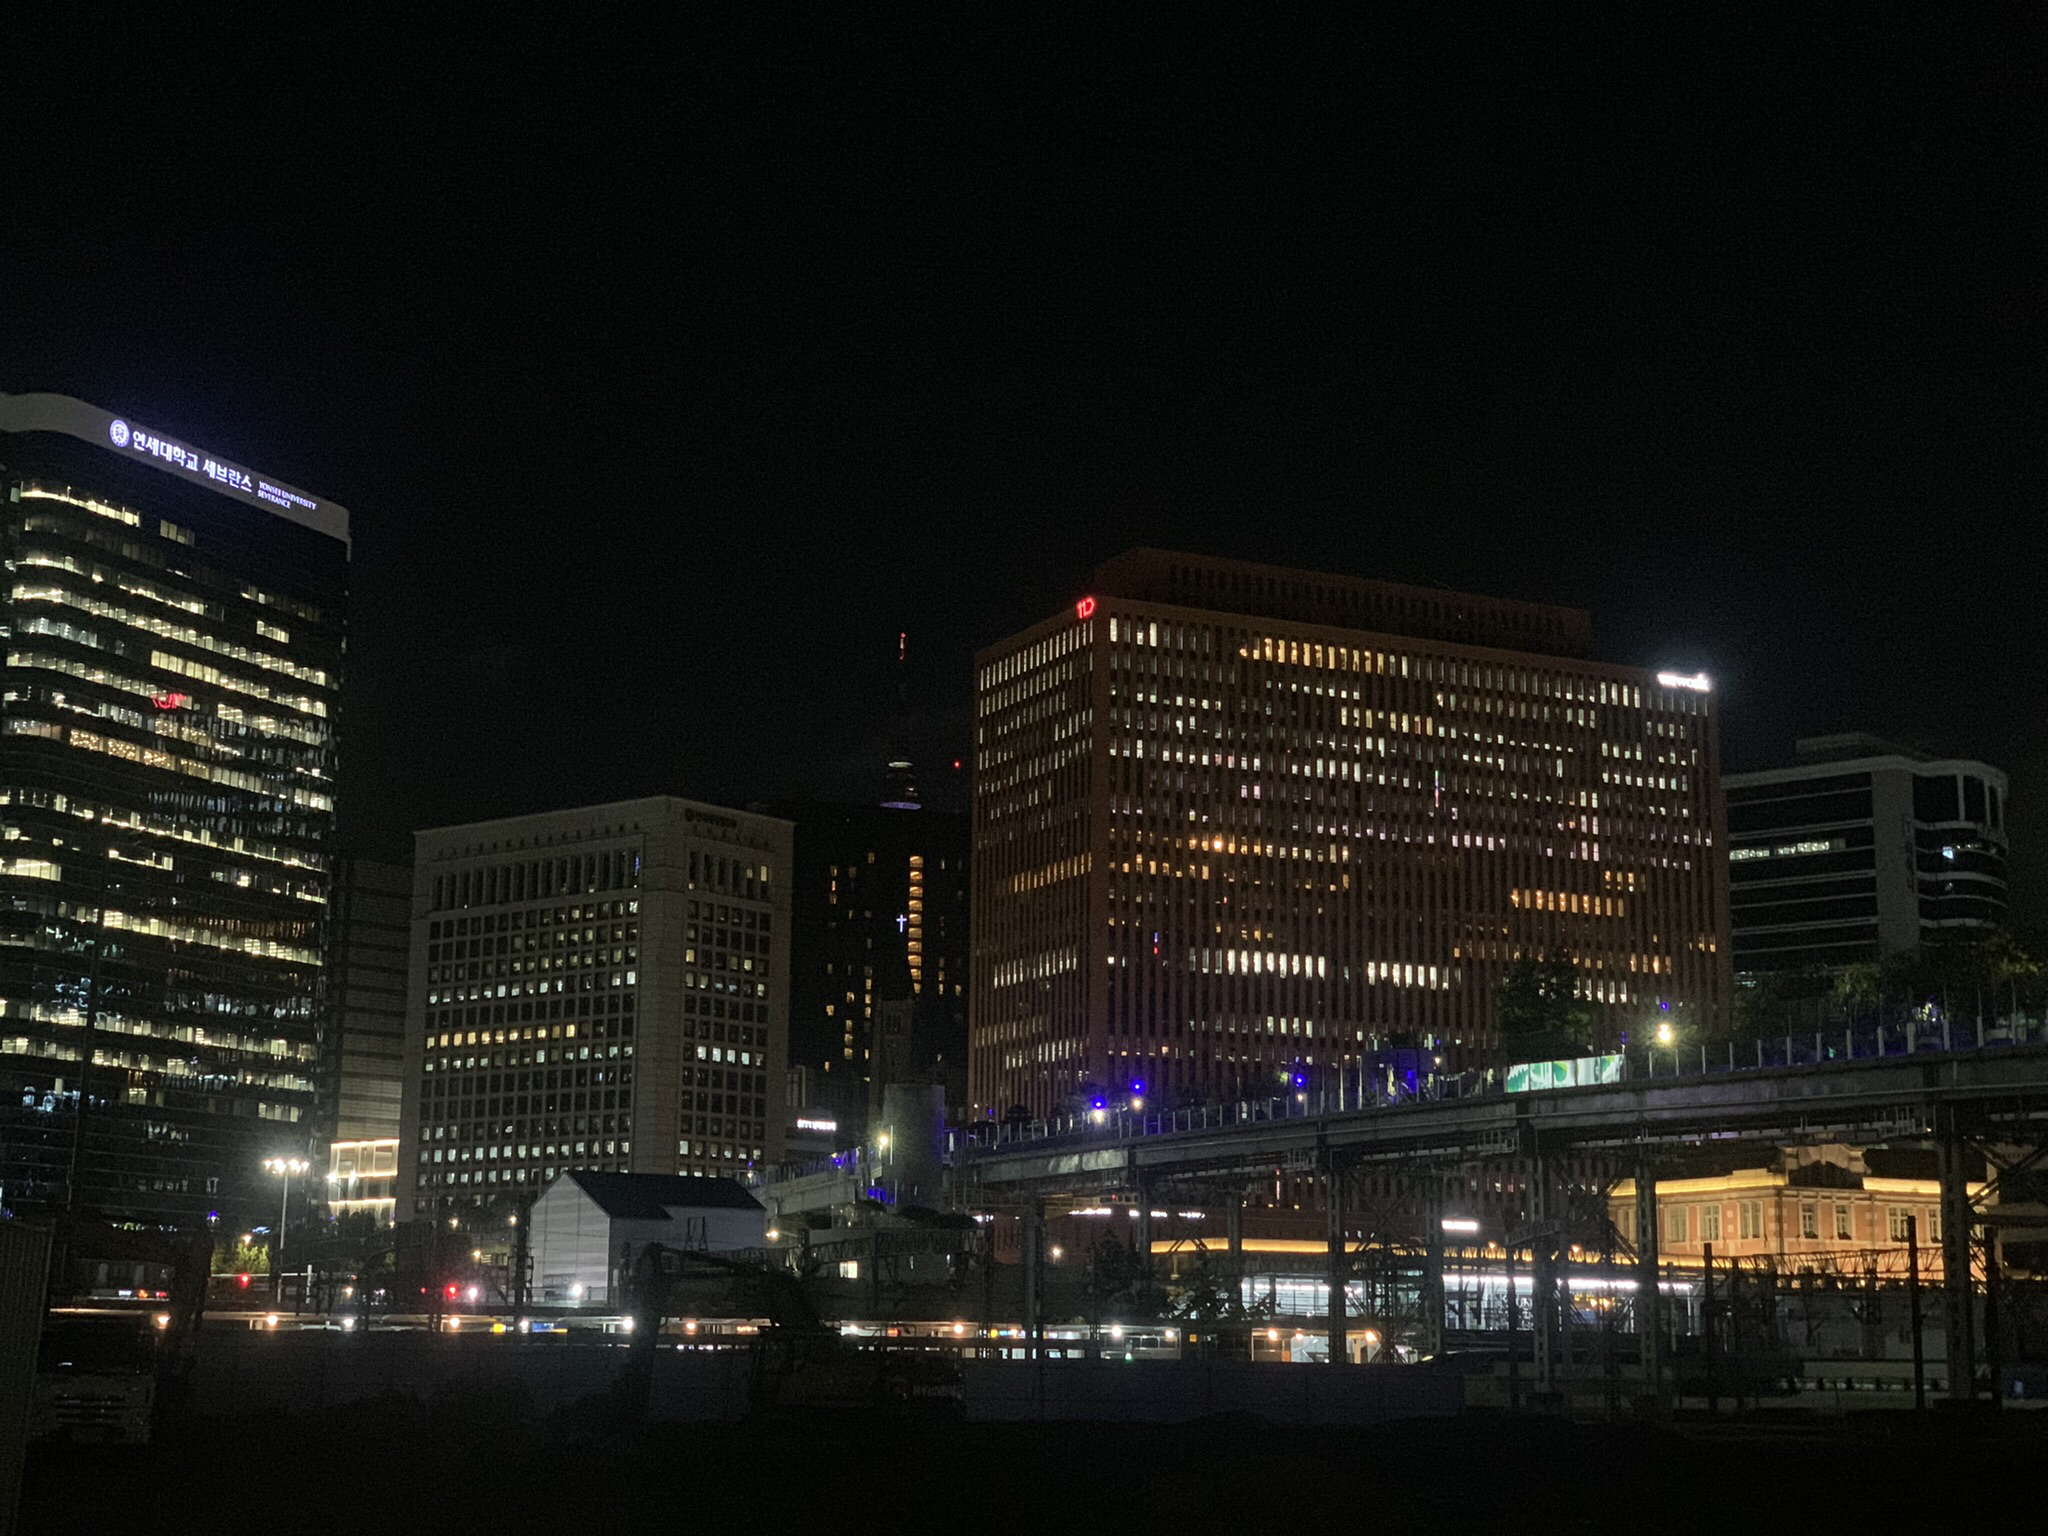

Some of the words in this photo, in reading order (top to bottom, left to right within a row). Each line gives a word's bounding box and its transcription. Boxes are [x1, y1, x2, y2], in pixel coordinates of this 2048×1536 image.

[132, 430, 199, 472] 연세대학교
[202, 458, 253, 493] 세브란스
[257, 489, 291, 509] SEVERANCE
[258, 480, 281, 497] YONSEI
[281, 490, 317, 510] UNIVERSITY
